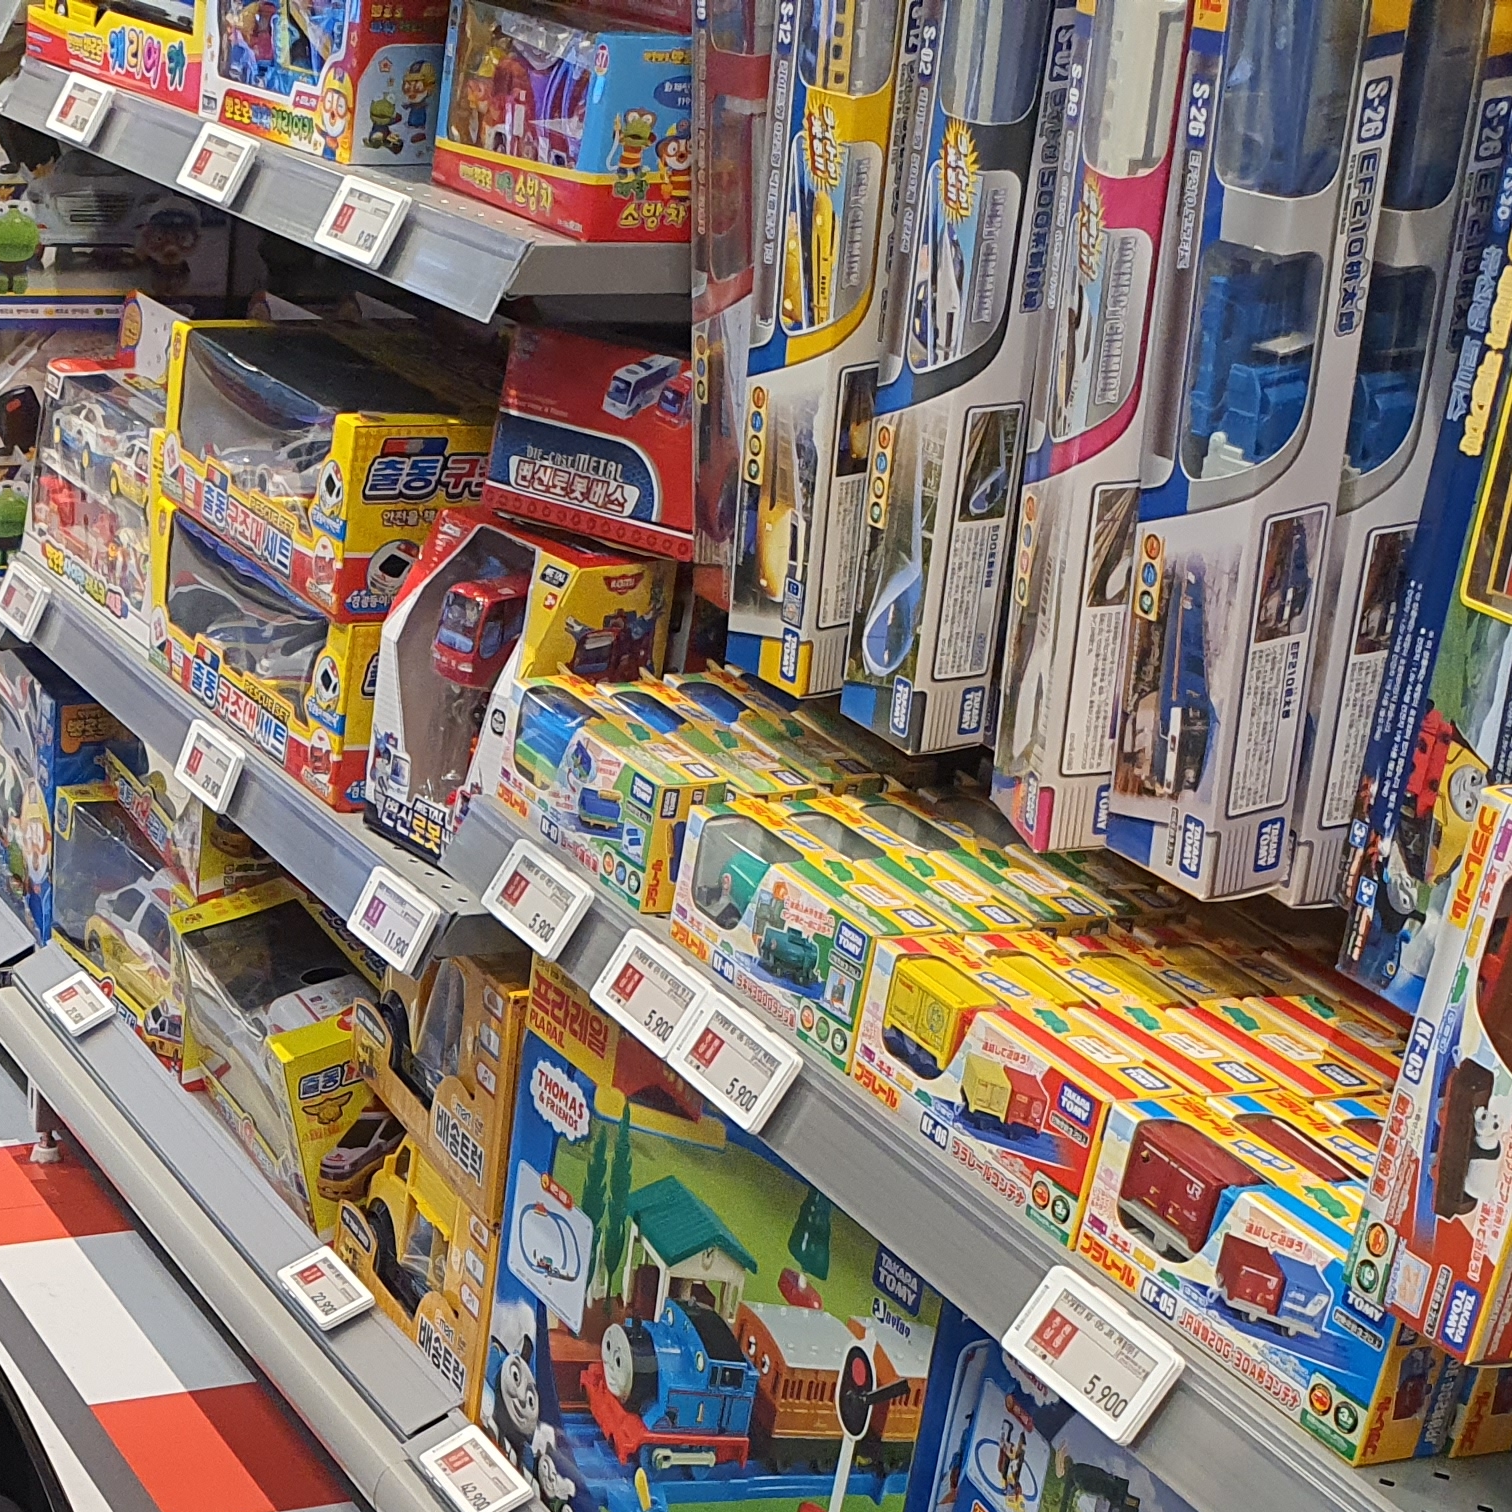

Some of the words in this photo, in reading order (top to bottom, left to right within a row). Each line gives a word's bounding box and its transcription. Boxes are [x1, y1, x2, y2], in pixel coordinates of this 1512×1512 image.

[777, 3, 794, 46] S-12
[166, 38, 186, 91] 카
[920, 25, 937, 77] S-02
[1065, 62, 1083, 117] S-08
[1189, 82, 1209, 138] S-26
[1360, 80, 1390, 139] S-26
[1478, 100, 1508, 159] S-26
[618, 201, 687, 231] 소방차
[1337, 151, 1381, 335] EF210桃太郎
[366, 457, 442, 500] 출동
[516, 461, 629, 512] 변신로봇버스
[575, 452, 624, 481] METAL
[202, 478, 228, 531] 출동
[228, 503, 263, 555] 구조대
[264, 525, 292, 576] 세트
[191, 660, 218, 704] 출동
[218, 680, 256, 734] 구조대
[256, 707, 288, 760] 세트
[890, 682, 902, 733] TOMY
[960, 690, 974, 729] TOMY
[1180, 820, 1194, 873] TOMY
[1255, 823, 1271, 867] TOMY
[1450, 806, 1499, 920] プラレール
[386, 927, 411, 957] 11,900
[528, 913, 555, 943] 5,900
[671, 921, 710, 961] プラレール
[836, 935, 863, 961] TOMY
[528, 1011, 566, 1051] PLARAIL
[531, 978, 611, 1060] 프라레일
[643, 1009, 674, 1042] 5,900
[1405, 1019, 1434, 1082] KF-03
[537, 1070, 586, 1122] THOMAS
[725, 1078, 757, 1111] 5,900
[853, 1060, 901, 1111] プラレール
[1060, 1095, 1089, 1121] TOMY
[1062, 1084, 1091, 1110] TAKARA
[538, 1091, 547, 1104] &
[545, 1096, 580, 1132] FRIENDS
[919, 1113, 949, 1148] KF-06
[436, 1104, 485, 1185] 배송트럭
[880, 1251, 919, 1292] TAKARA
[1079, 1233, 1138, 1291] プラレール
[878, 1268, 917, 1306] TOMY
[1140, 1277, 1177, 1320] KF-05
[1346, 1290, 1384, 1323] TOMY
[1444, 1289, 1468, 1341] TOMY
[1454, 1292, 1476, 1344] TAKARA
[417, 1315, 465, 1397] 배송트럭
[1082, 1373, 1129, 1419] 5,900
